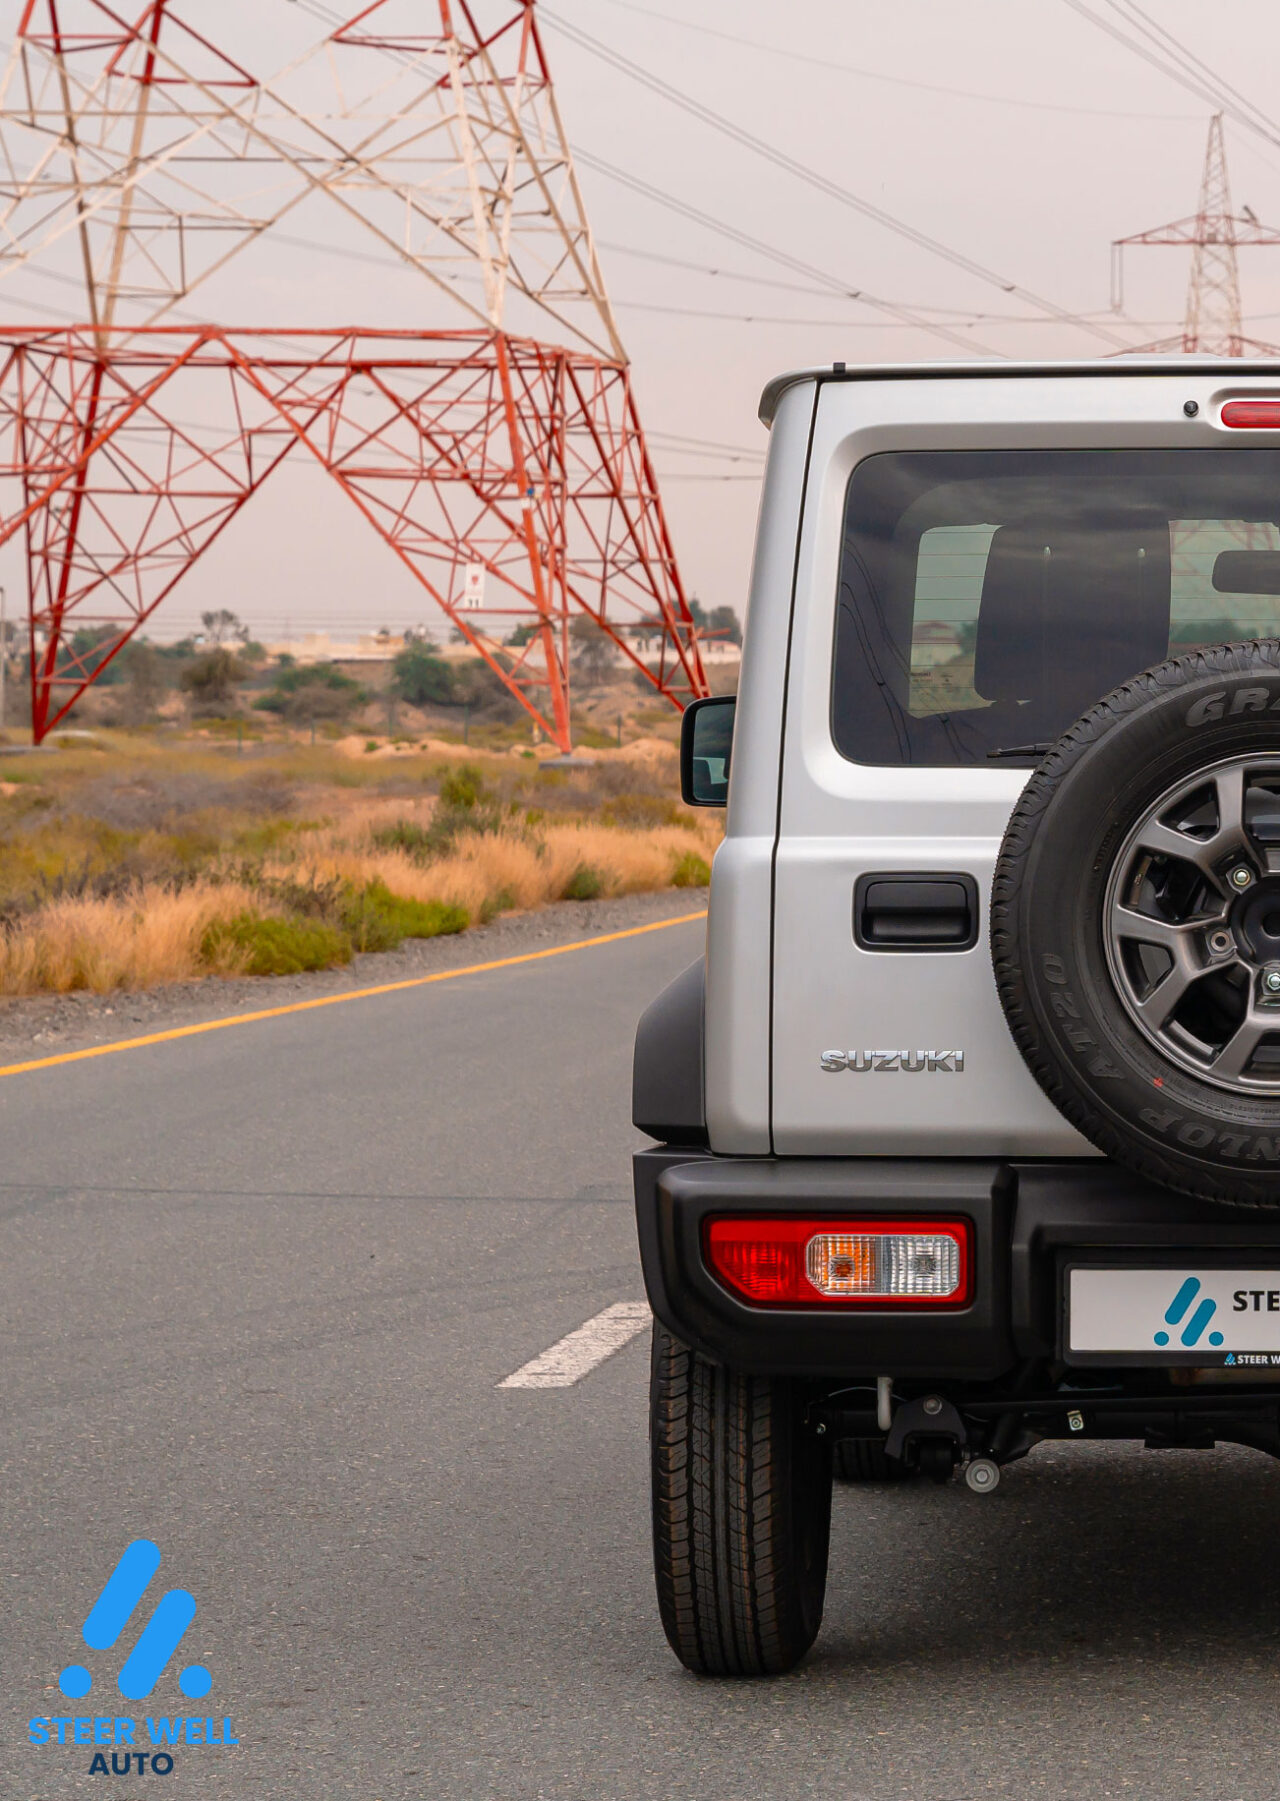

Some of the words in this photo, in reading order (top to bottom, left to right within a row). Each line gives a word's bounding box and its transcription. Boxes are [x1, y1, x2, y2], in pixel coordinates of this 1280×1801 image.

[1040, 952, 1126, 1080] AT20
[820, 1050, 965, 1073] SUZUKI
[1237, 1354, 1269, 1365] STEER
